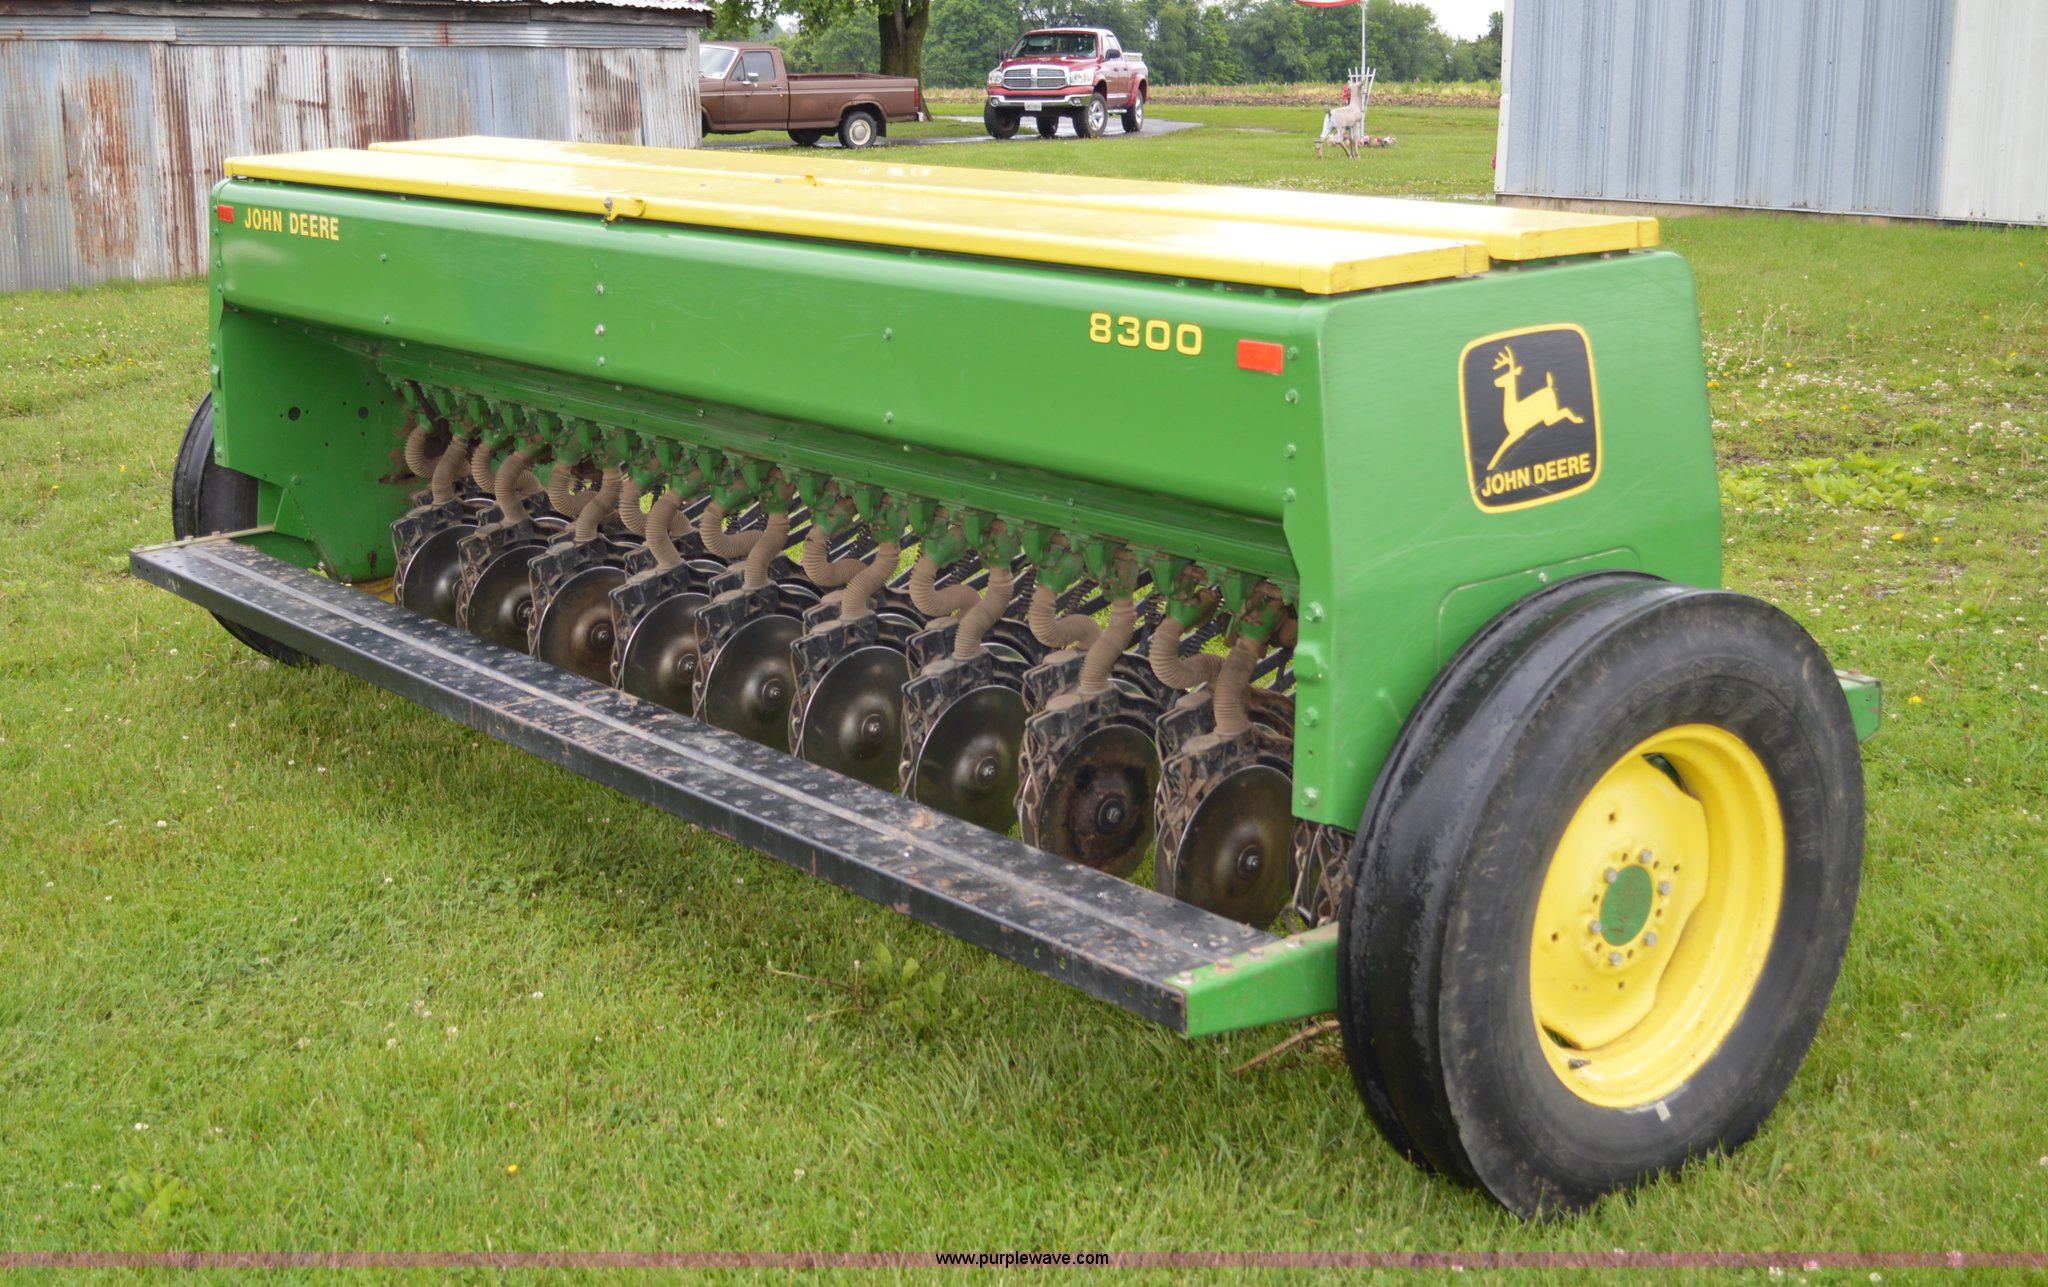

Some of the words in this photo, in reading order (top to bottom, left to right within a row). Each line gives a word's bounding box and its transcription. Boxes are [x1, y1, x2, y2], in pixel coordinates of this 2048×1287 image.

[245, 207, 283, 233] JOHN
[289, 212, 340, 241] DEERE
[1089, 311, 1203, 356] 8300
[1480, 466, 1531, 498] JOHN
[1533, 453, 1592, 485] DEERE
